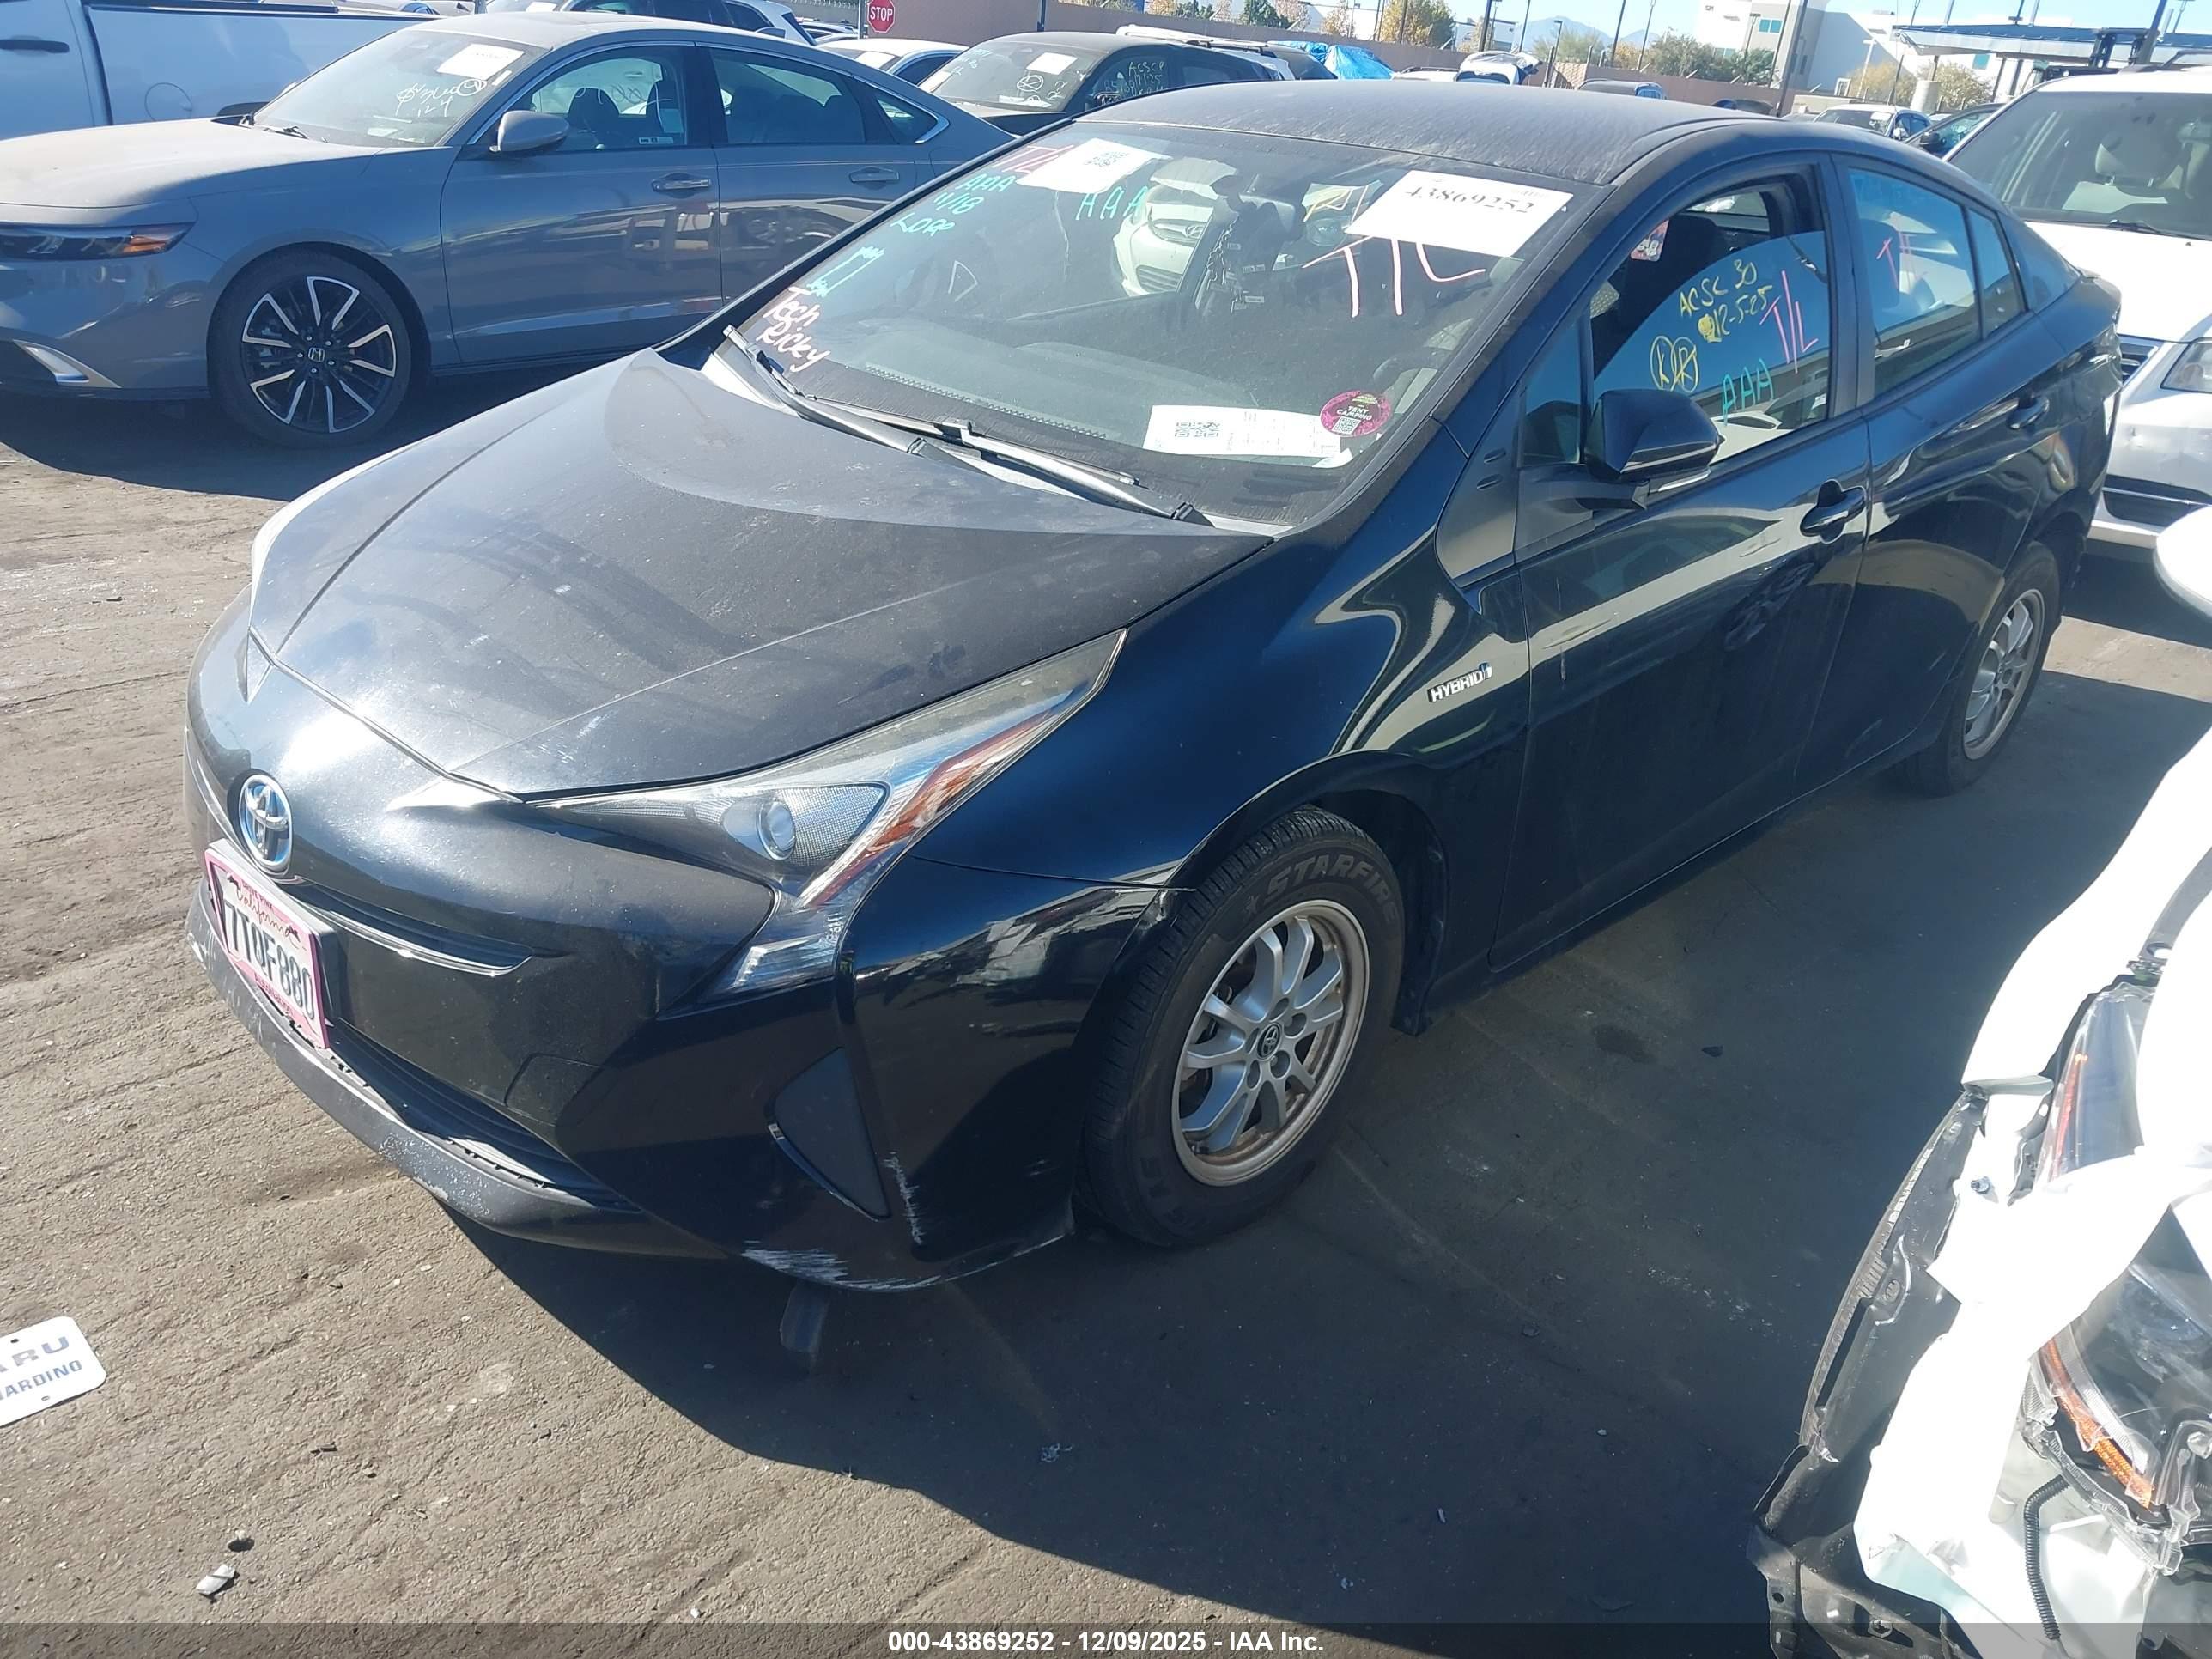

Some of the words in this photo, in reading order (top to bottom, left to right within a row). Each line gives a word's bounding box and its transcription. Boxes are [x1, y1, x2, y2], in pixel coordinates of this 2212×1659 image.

[870, 6, 893, 21] STOP
[1405, 185, 1535, 215] 43869252
[1336, 409, 1373, 420] CAMPING
[1427, 669, 1486, 702] HYBRID
[1267, 854, 1398, 922] STARFIRE
[225, 899, 314, 1021] 7TQF880
